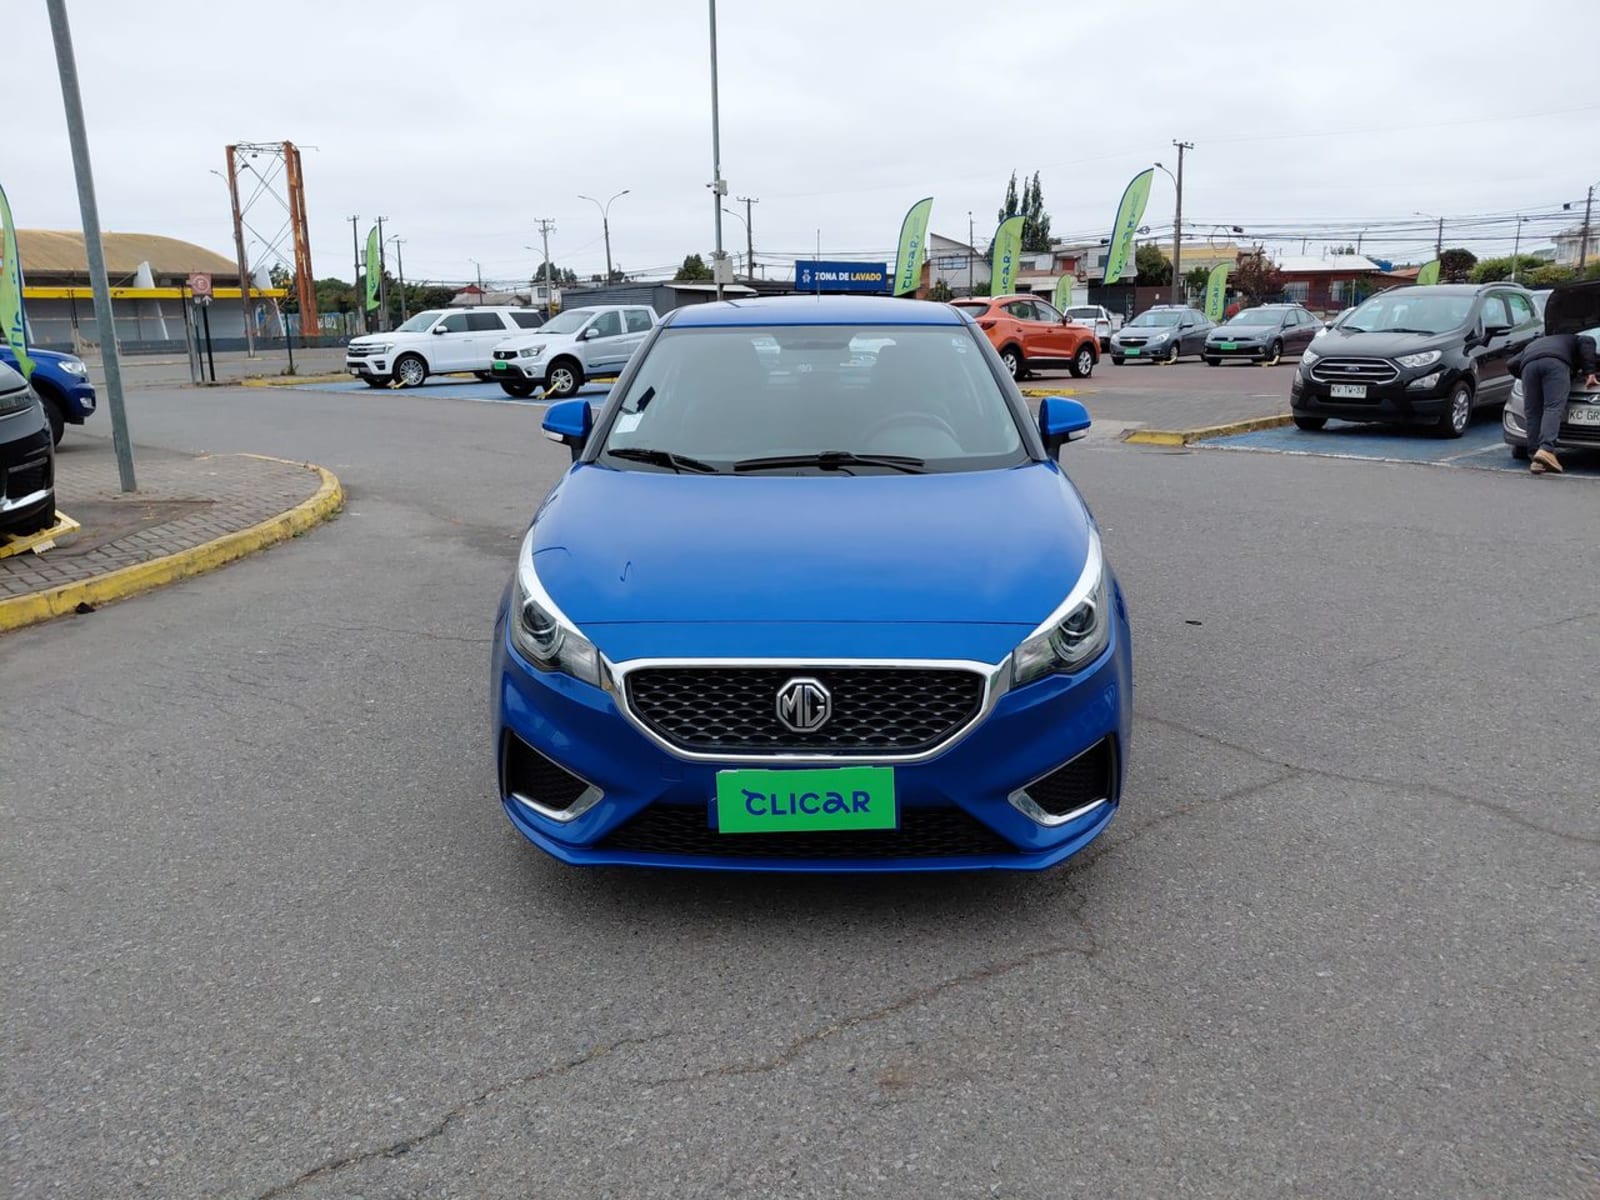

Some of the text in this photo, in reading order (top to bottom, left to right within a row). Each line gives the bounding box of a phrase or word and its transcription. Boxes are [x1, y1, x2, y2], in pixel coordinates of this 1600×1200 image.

[815, 272, 882, 281] ZONA DE LAVADO
[1002, 255, 1011, 294] ICaR
[781, 683, 826, 728] MG
